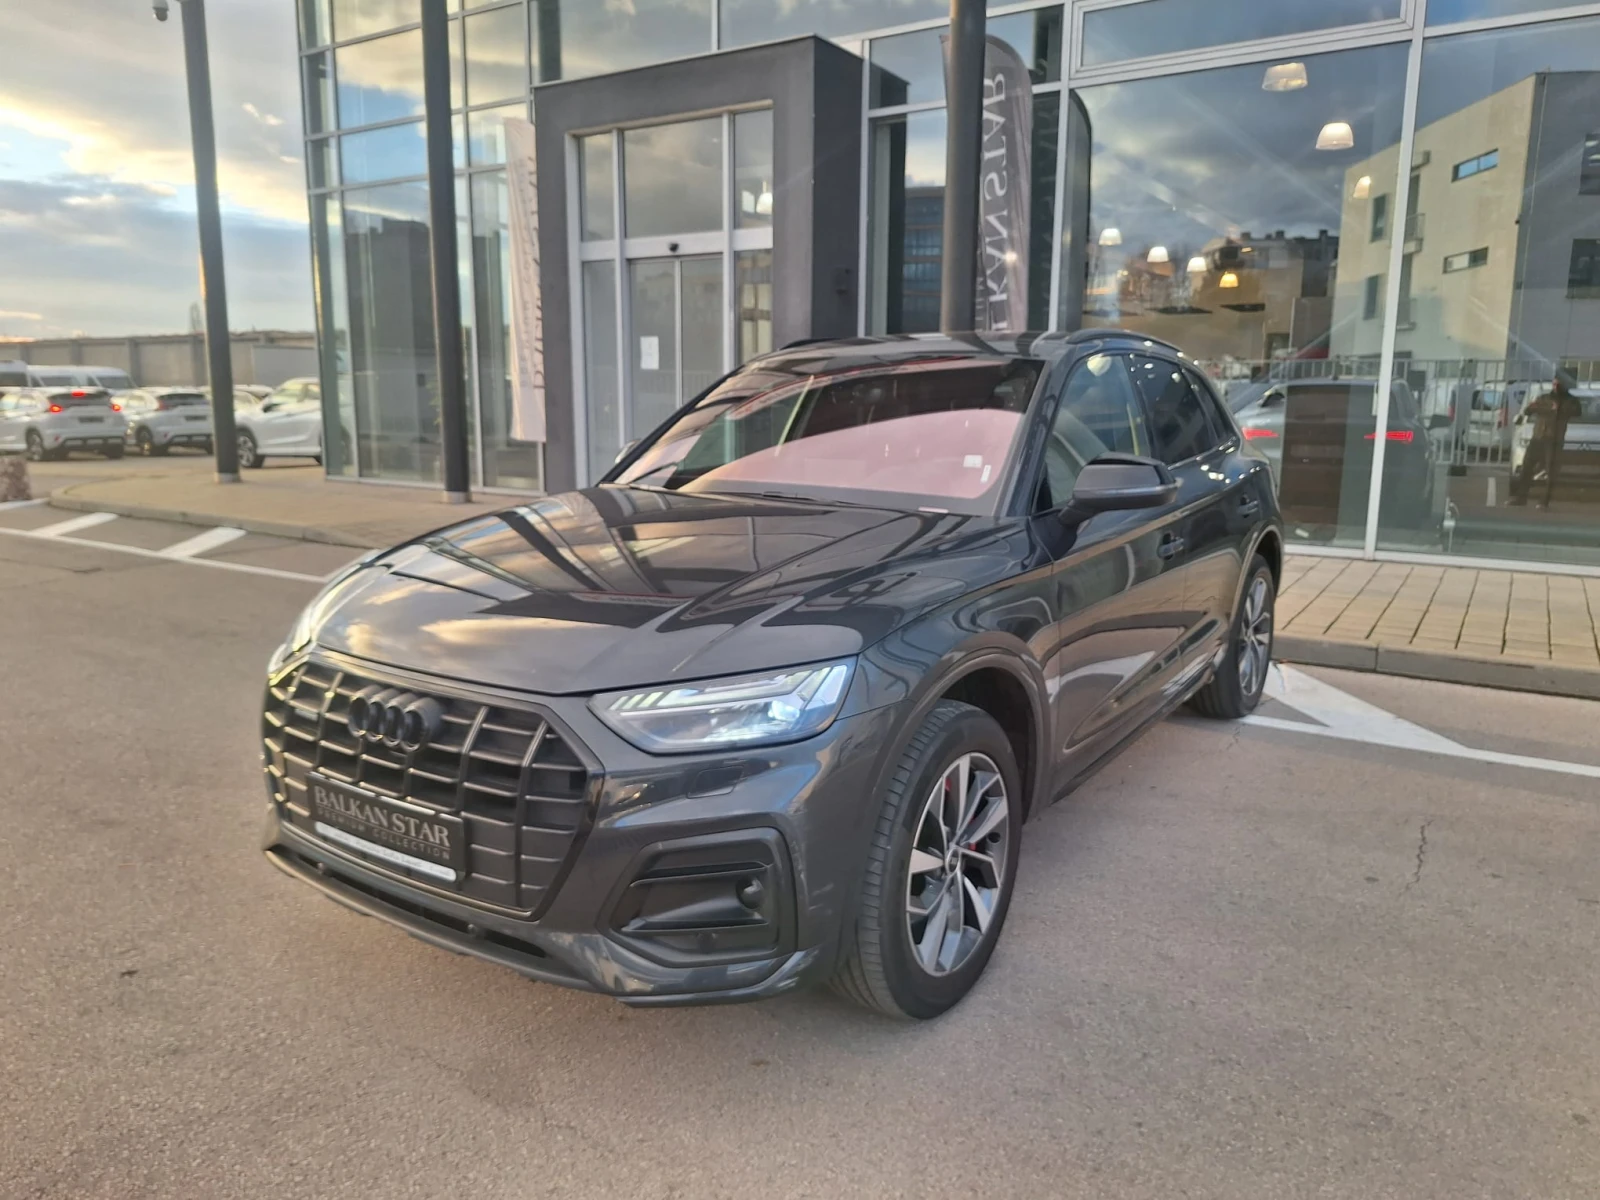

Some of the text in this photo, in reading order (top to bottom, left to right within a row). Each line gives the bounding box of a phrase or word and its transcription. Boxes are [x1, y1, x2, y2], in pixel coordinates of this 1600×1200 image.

[314, 785, 452, 848] BALKAN STAR
[372, 827, 451, 861] COLLECTION
